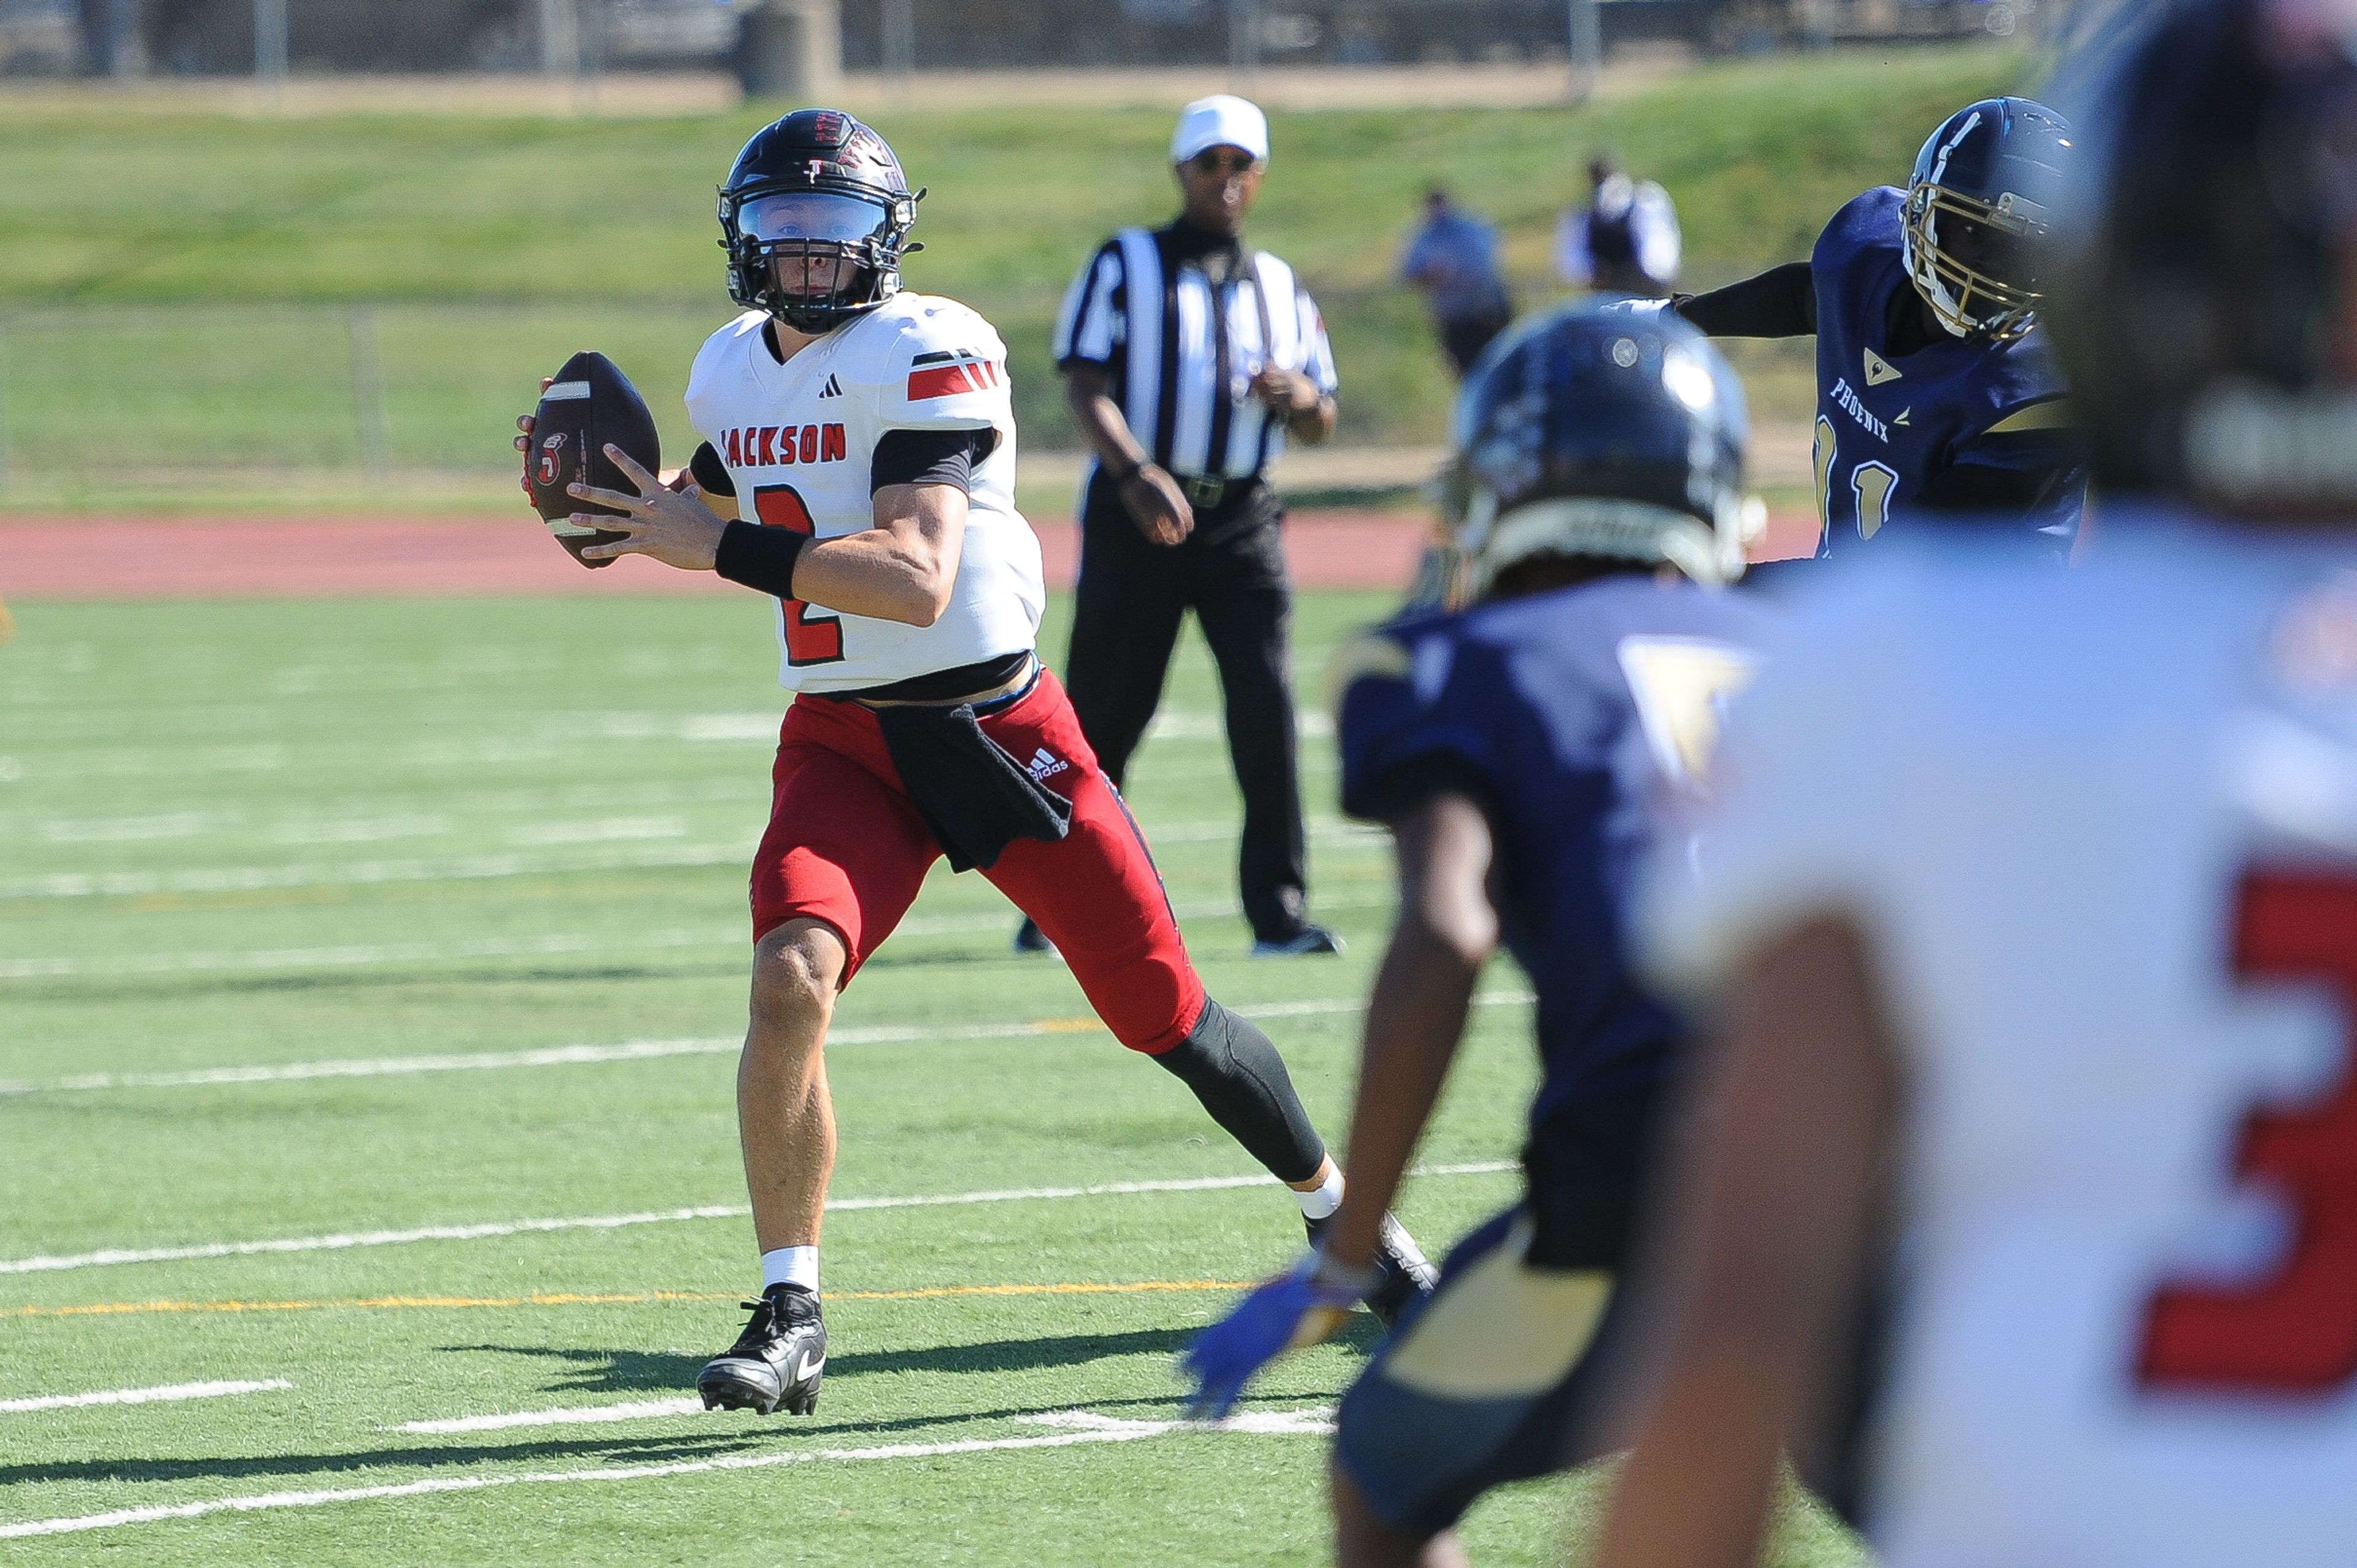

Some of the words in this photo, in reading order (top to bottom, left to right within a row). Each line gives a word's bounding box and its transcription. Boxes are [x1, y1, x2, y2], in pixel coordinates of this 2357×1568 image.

[1830, 377, 1888, 443] PHOENIX
[753, 483, 846, 668] 2
[2136, 865, 2357, 1396] 3
